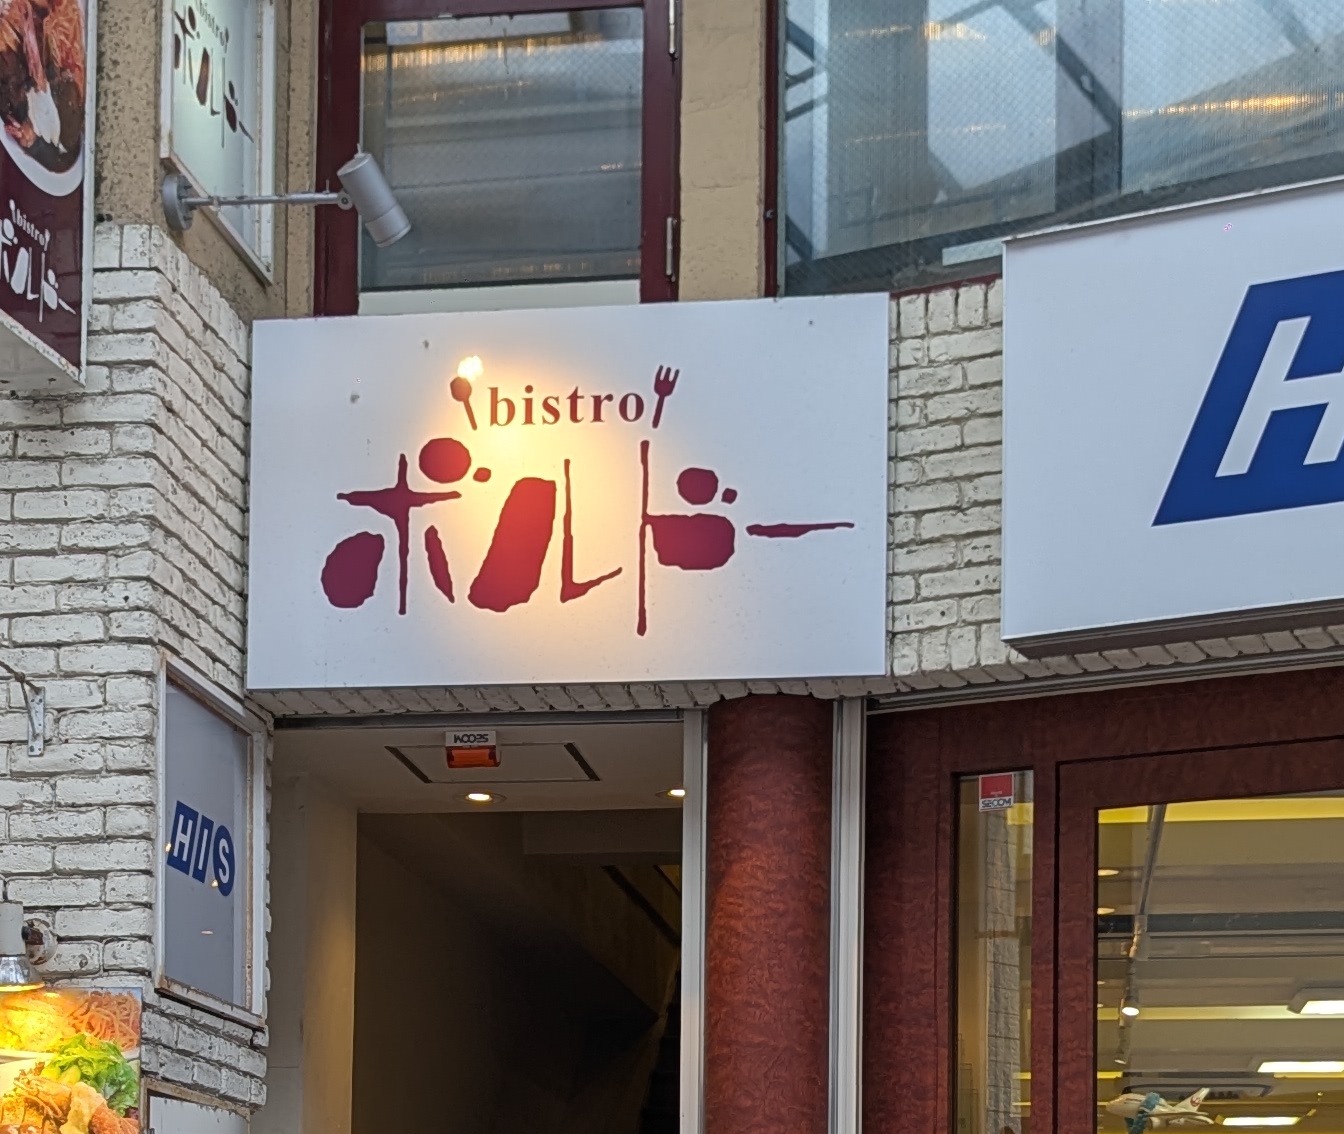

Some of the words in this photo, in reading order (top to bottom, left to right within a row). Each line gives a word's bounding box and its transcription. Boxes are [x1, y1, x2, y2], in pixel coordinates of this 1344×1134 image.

[17, 212, 46, 246] bistro
[488, 385, 645, 428] bistro
[321, 437, 855, 636] ボルドー
[167, 800, 235, 896] HIS
